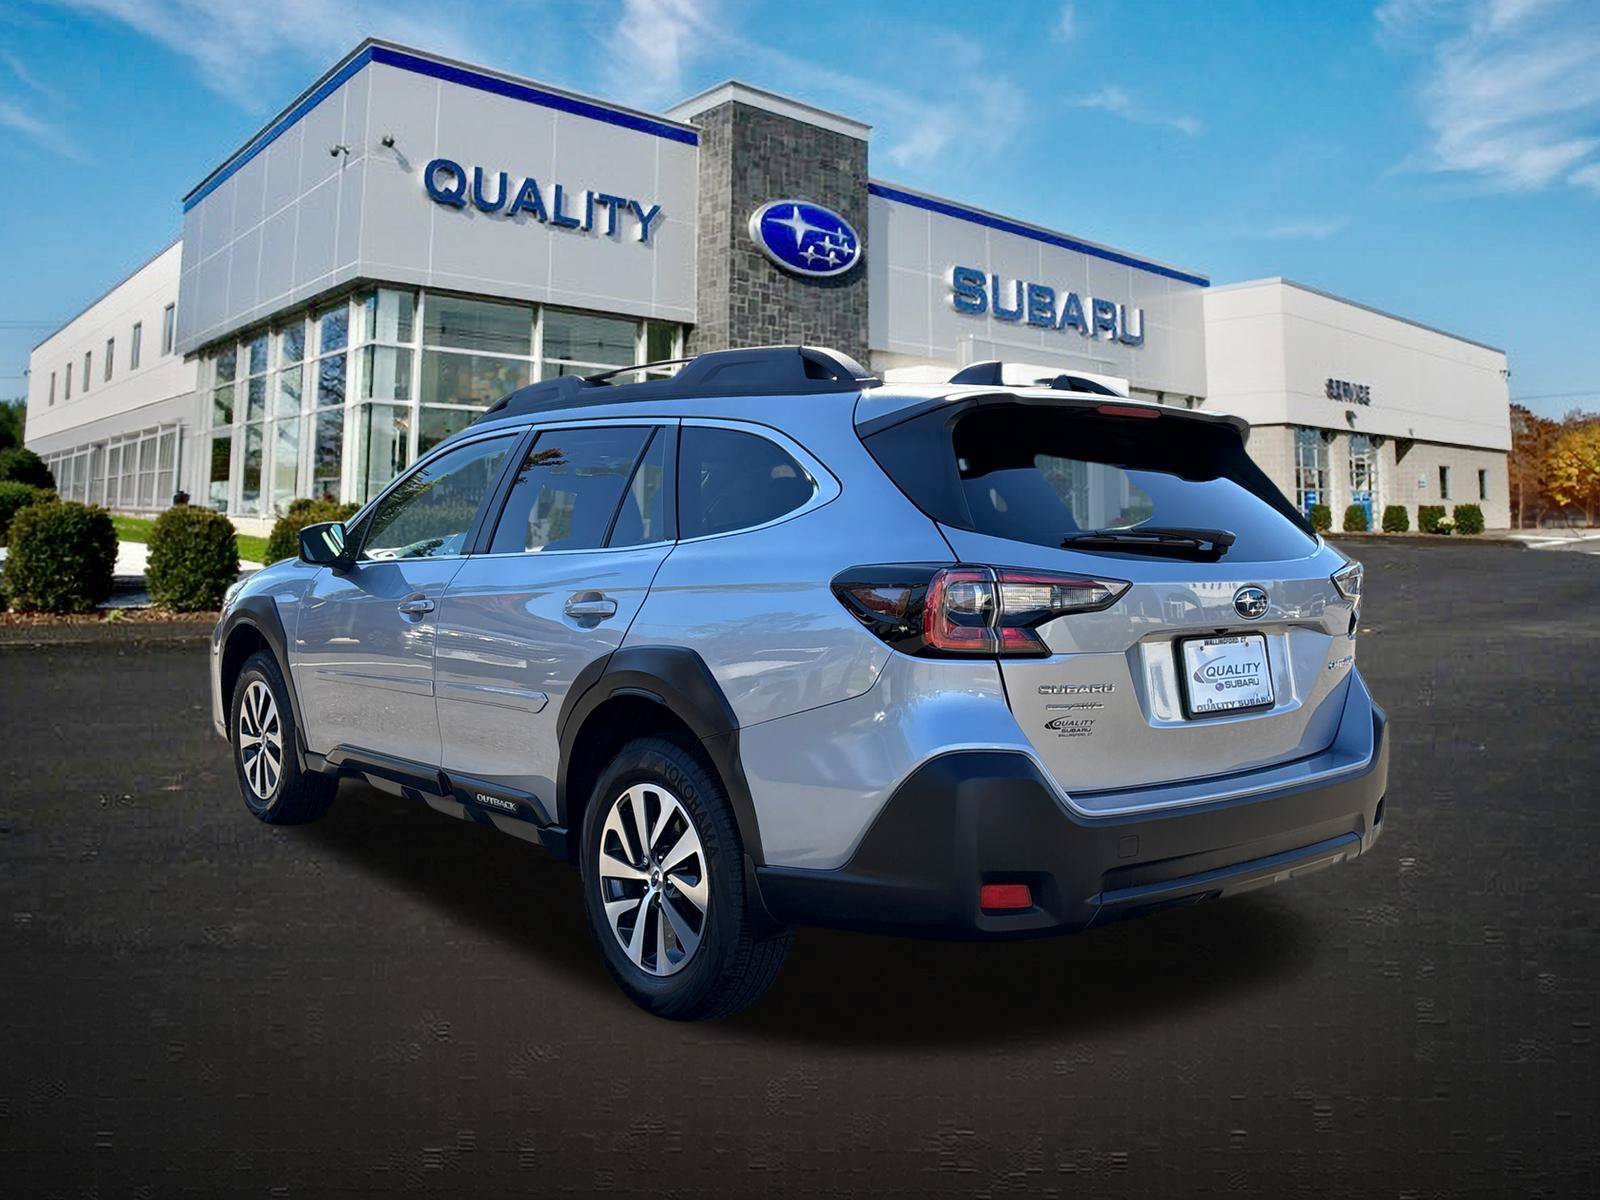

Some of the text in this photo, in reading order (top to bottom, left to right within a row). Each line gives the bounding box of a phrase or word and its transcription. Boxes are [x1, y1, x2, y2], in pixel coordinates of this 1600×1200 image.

[424, 158, 662, 243] QUALITY
[946, 265, 1145, 347] SUBARU
[1325, 378, 1371, 407] SERVICE
[1206, 662, 1261, 677] QUALITY
[1039, 684, 1116, 695] SUBARU
[1225, 678, 1260, 689] SUBARU
[1197, 696, 1272, 712] QUALITY SUBARU
[1053, 719, 1096, 727] QUALITY
[476, 793, 518, 812] OUTBACK
[663, 760, 718, 858] YOKOHAMA
